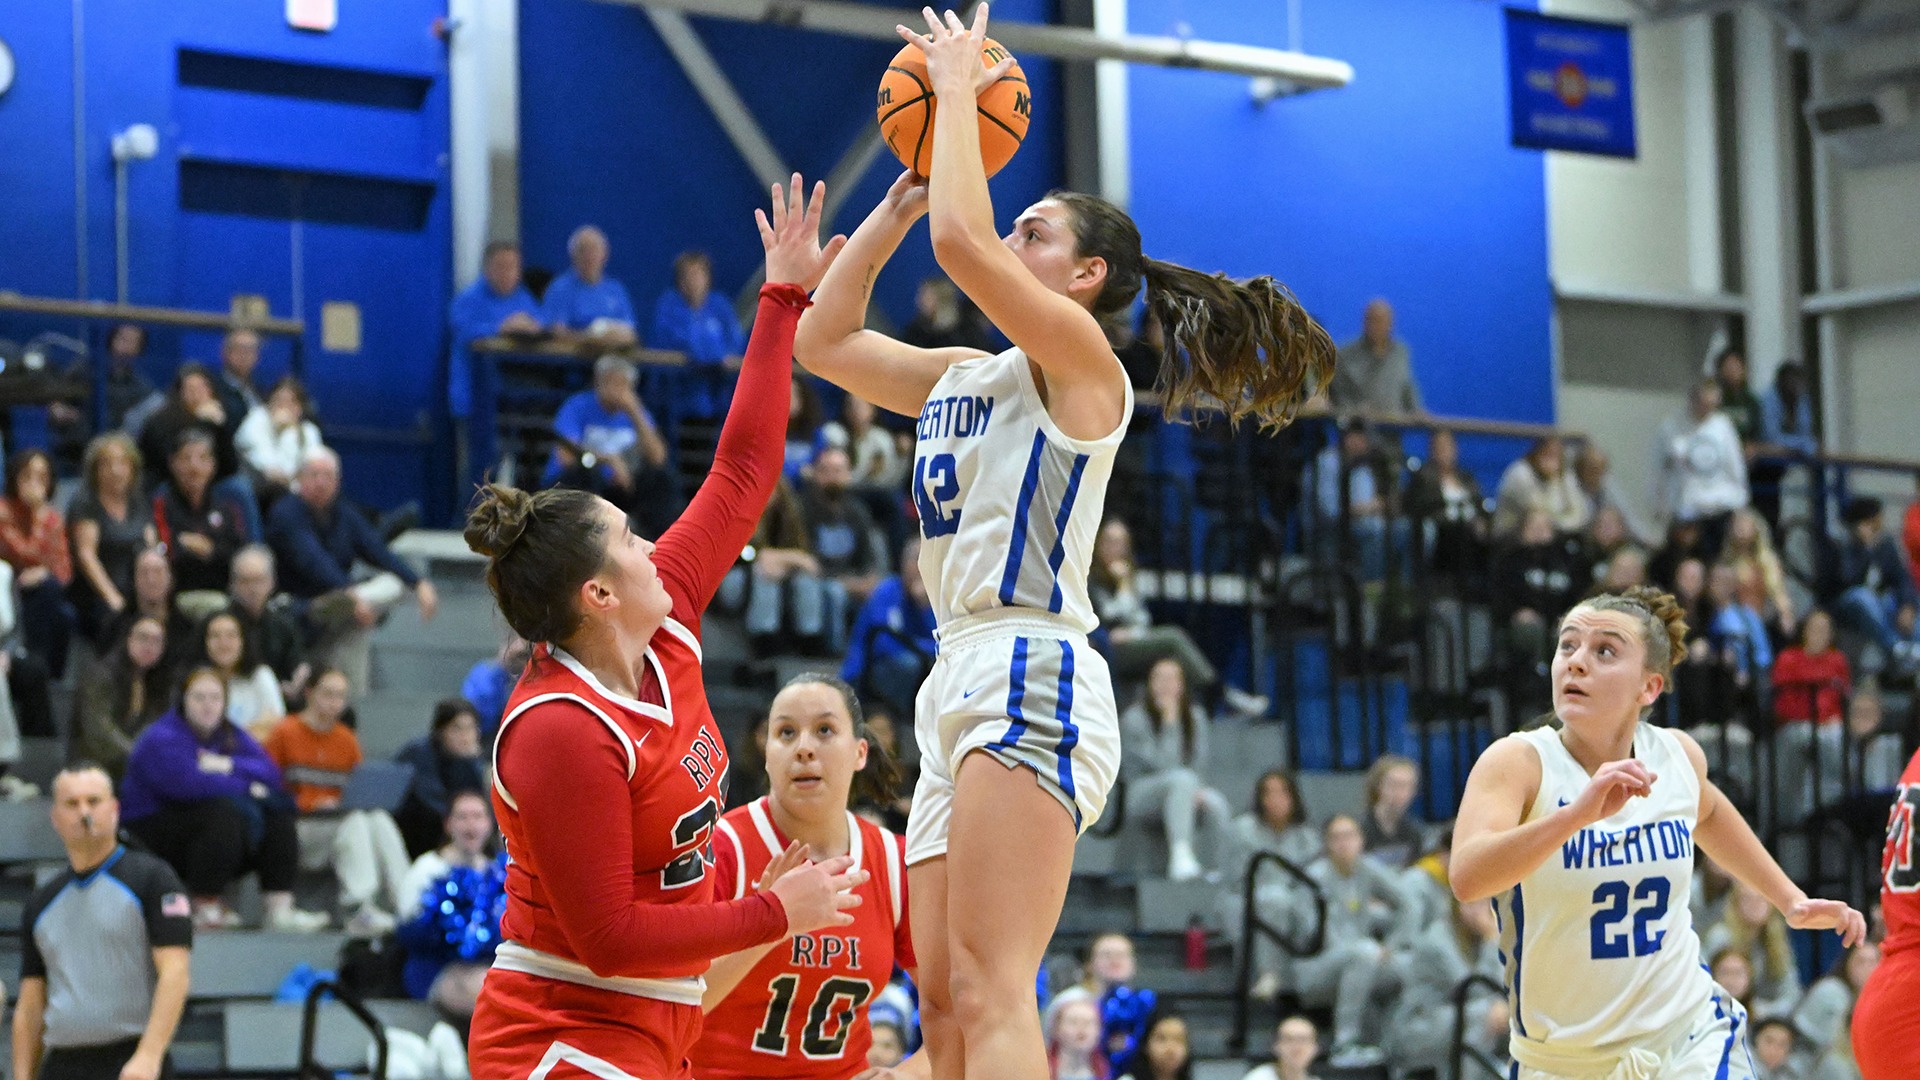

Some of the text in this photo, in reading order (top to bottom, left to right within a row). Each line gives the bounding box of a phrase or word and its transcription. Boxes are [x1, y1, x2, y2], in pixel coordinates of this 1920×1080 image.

[917, 396, 994, 441] HEATON
[680, 725, 723, 792] RPI
[1562, 819, 1691, 869] WHEATON
[1590, 876, 1671, 960] 22
[791, 934, 862, 970] RPI
[751, 973, 873, 1060] 10
